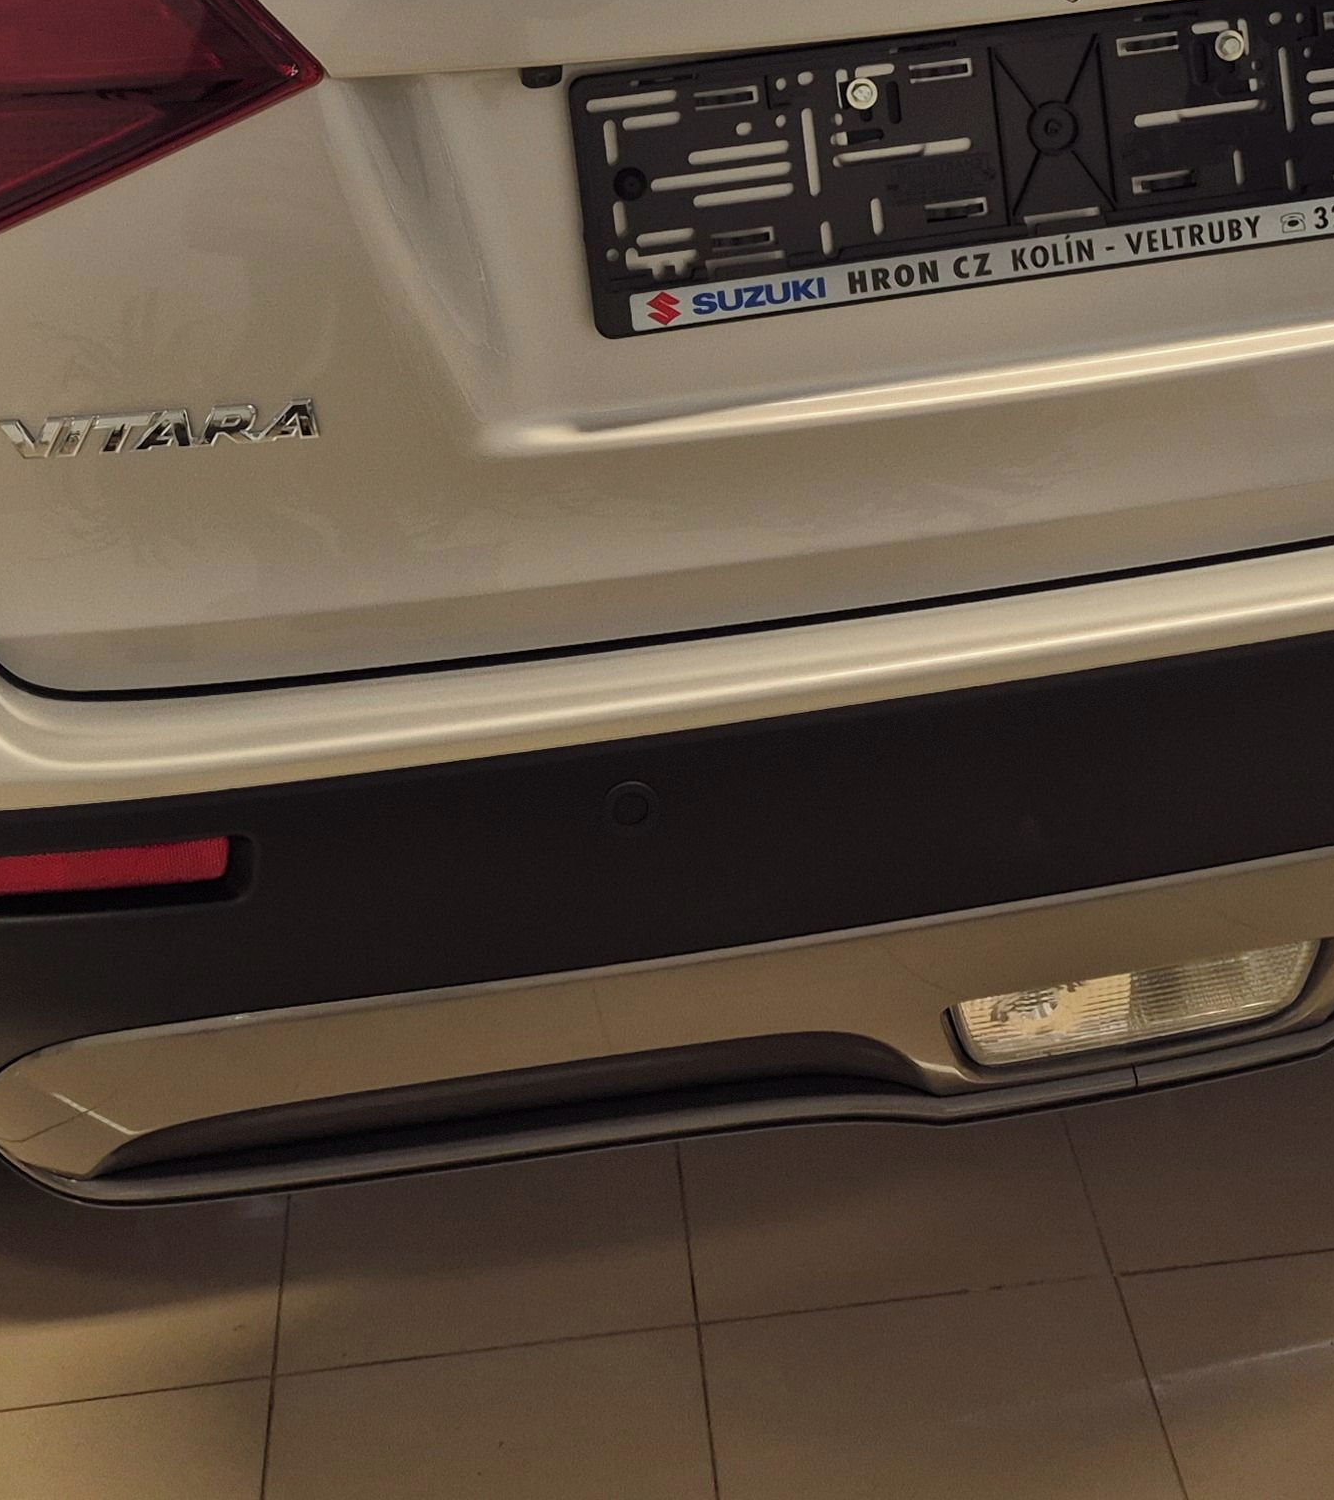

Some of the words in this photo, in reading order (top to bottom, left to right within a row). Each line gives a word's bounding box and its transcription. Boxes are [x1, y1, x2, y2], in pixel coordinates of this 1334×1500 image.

[692, 276, 827, 316] SUZUKI
[847, 260, 940, 295] HRON
[953, 252, 993, 279] CZ
[1011, 235, 1096, 272] KOLÍN
[1124, 215, 1262, 255] VELTRUBY
